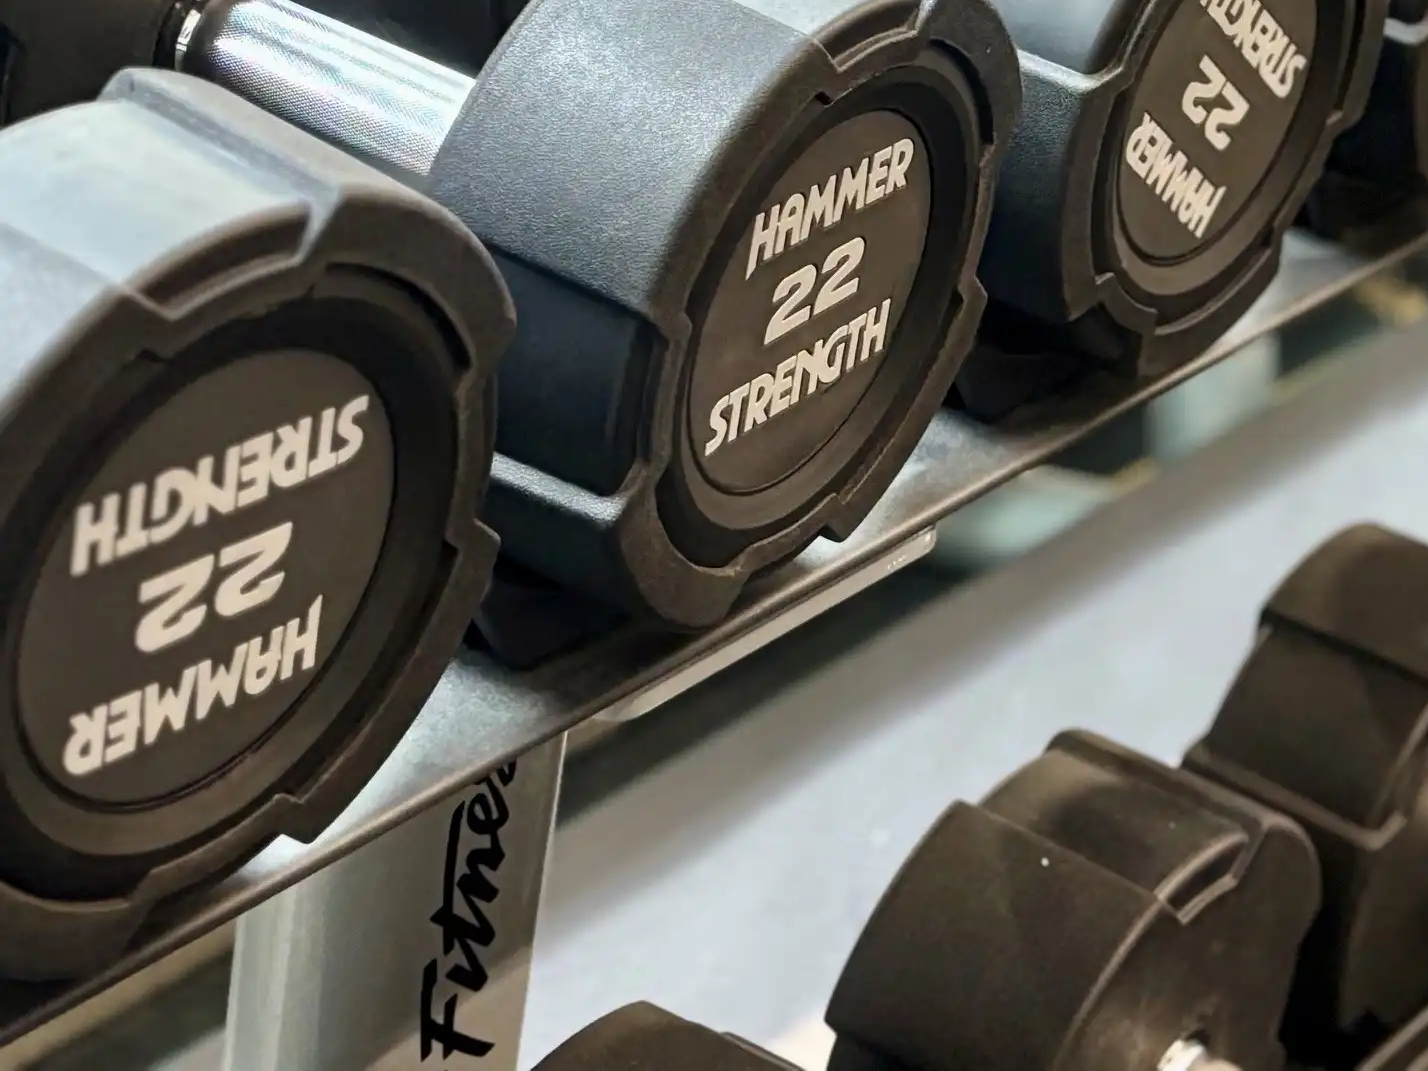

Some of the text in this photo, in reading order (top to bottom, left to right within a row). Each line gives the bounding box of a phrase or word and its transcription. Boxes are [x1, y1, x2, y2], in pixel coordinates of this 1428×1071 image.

[1182, 55, 1250, 151] 22
[745, 137, 915, 280] HAMMER
[1125, 112, 1227, 238] HAMMER
[763, 236, 866, 346] 22
[704, 298, 892, 457] STRENGTH
[70, 395, 369, 577] STRENGTH
[135, 522, 293, 653] 22
[62, 594, 323, 776] HAMMER
